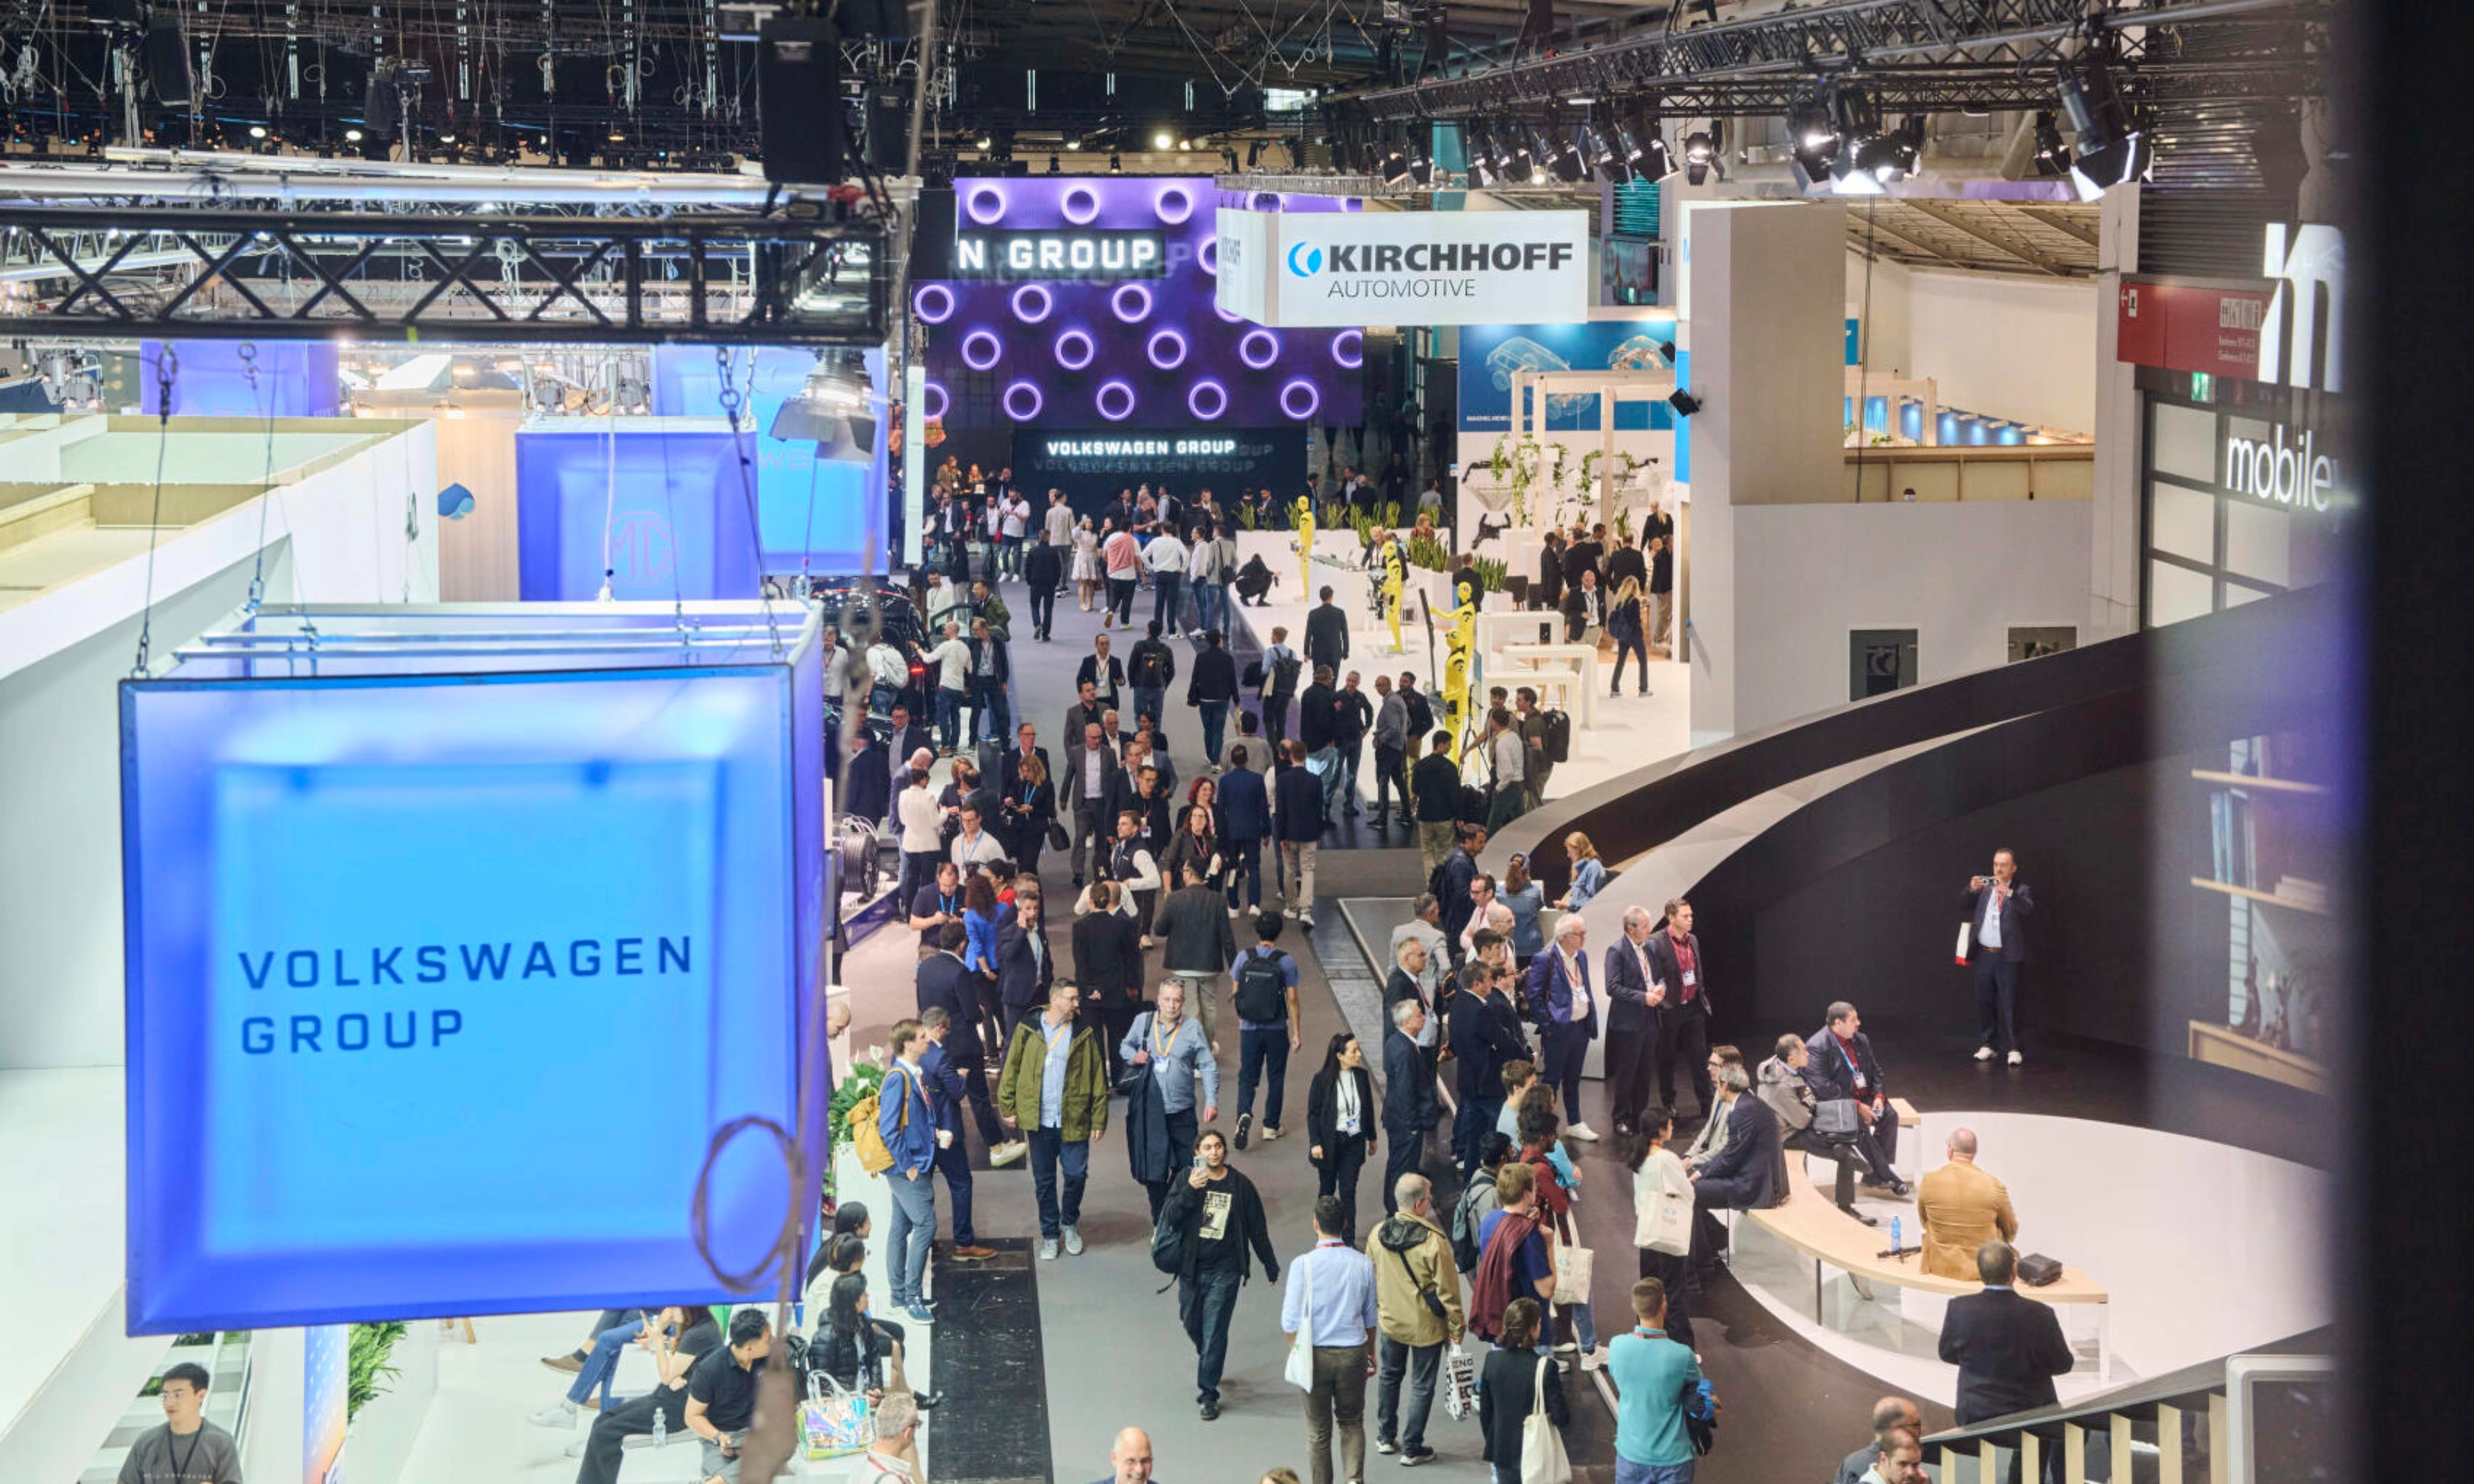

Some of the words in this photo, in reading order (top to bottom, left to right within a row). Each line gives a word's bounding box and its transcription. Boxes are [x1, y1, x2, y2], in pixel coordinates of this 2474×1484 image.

[959, 239, 984, 269] N
[1008, 239, 1156, 270] GROUP
[1330, 243, 1573, 273] KIRCHHOFF
[1327, 278, 1476, 298] AUTOMOTIVE
[1047, 440, 1169, 456] VOLKSWAGEN
[1175, 440, 1235, 454] GROUP
[2226, 424, 2335, 513] mobile
[238, 936, 691, 990] VOLKSWAGEN
[241, 1009, 462, 1055] GROUP
